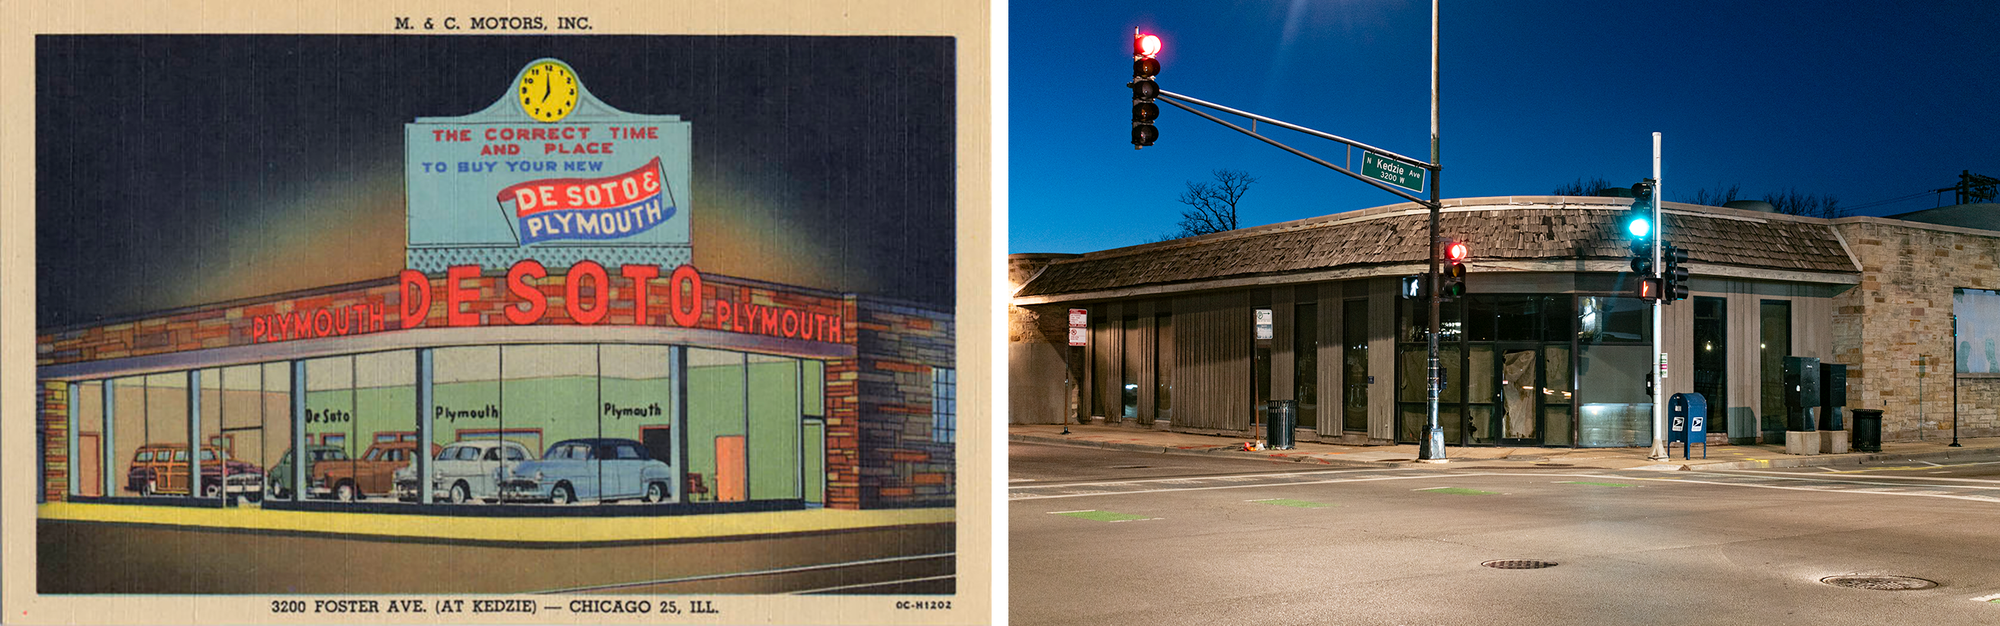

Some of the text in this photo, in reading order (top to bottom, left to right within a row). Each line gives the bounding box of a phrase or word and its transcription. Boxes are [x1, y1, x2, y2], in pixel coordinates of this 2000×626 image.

[394, 17, 593, 31] M. & C. MOTORS, INC.
[432, 126, 659, 141] THE CORRECT TIME
[480, 142, 613, 156] AND PLACE
[422, 160, 603, 173] TO BUY YOUR NEW
[1367, 157, 1421, 179] N Kedzie Ave
[1380, 171, 1397, 182] 3200
[515, 171, 659, 211] DE SOTO &
[527, 199, 662, 237] PLYMOUTH
[400, 258, 701, 329] DE SOTO
[252, 303, 385, 344] PLYMOUTH
[716, 300, 842, 343] PLYMOUTH
[435, 405, 499, 423] Plymouth
[271, 600, 306, 613] 3200
[314, 600, 379, 613] FOSTER
[387, 600, 427, 613] AVE.
[435, 600, 464, 614] (AT
[472, 600, 537, 614] KEDZIE)
[569, 600, 651, 613] CHICAGO
[660, 600, 681, 615] 25,
[690, 600, 719, 614] ILL.
[896, 601, 951, 610] OC-H1202
